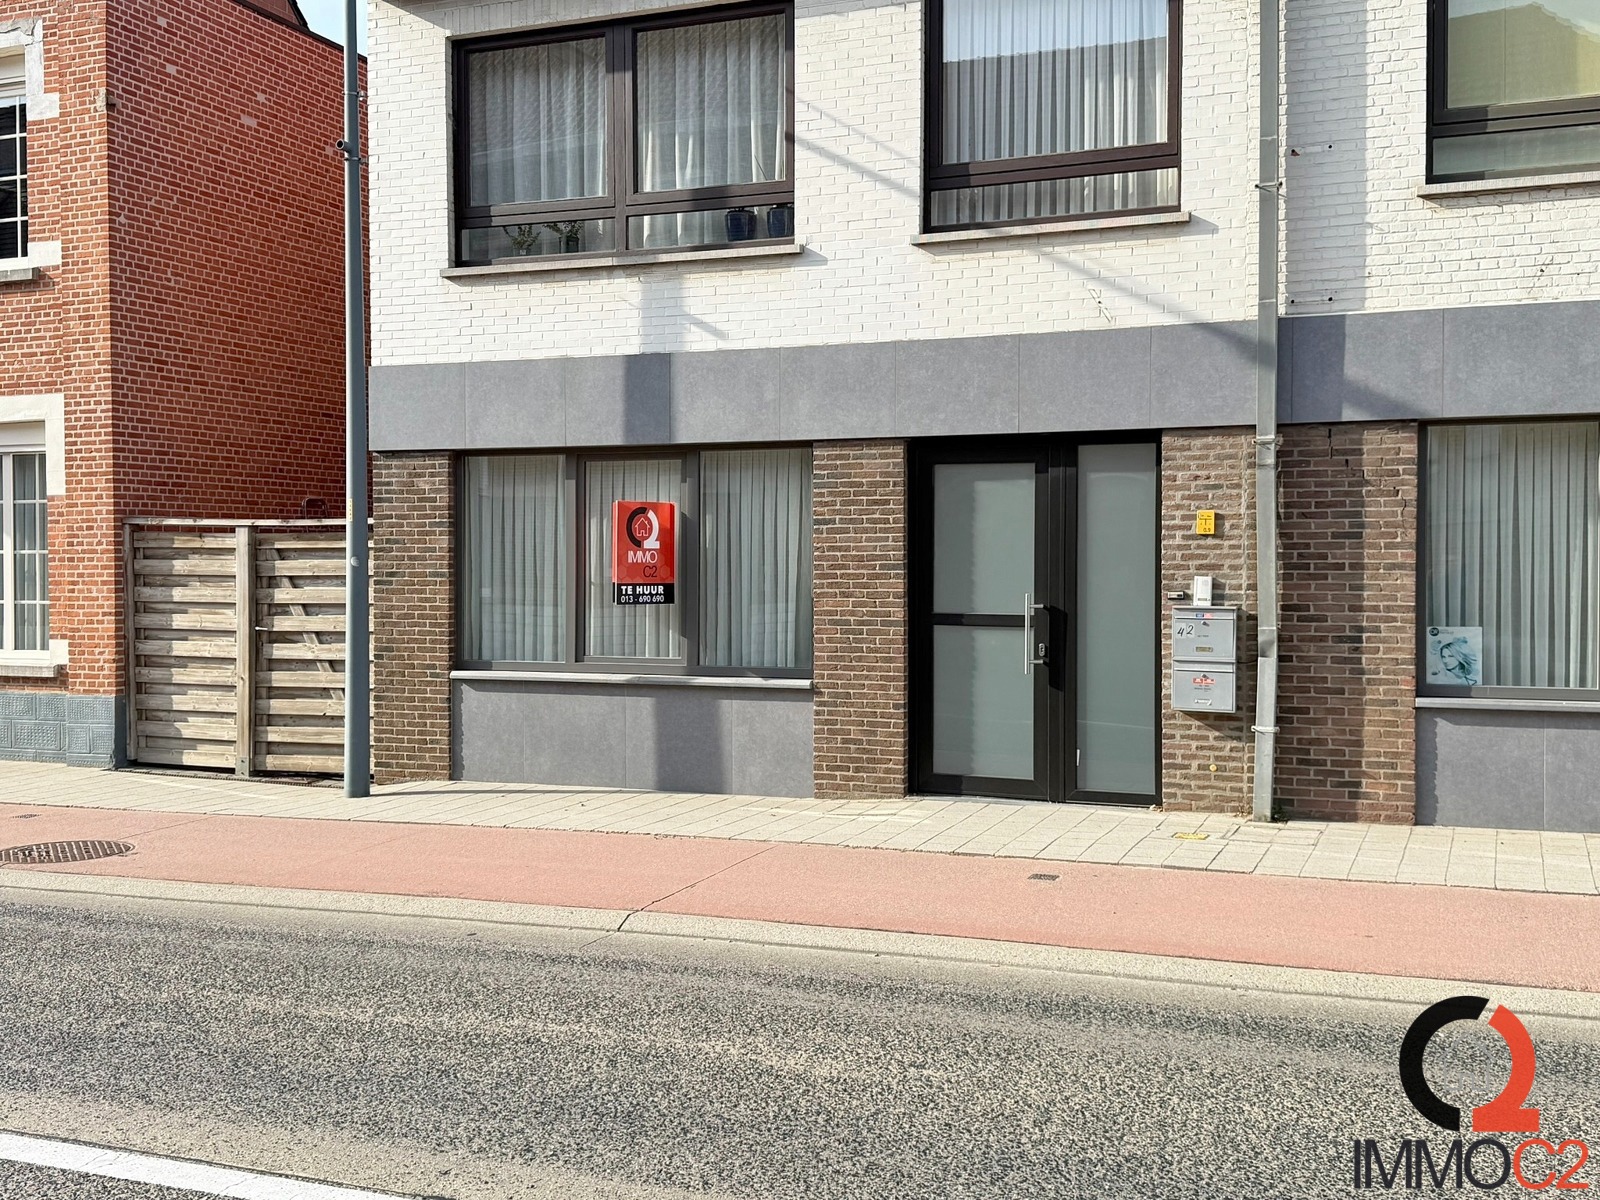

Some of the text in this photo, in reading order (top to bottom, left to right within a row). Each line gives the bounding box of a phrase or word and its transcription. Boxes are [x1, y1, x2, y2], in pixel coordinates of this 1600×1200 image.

[627, 550, 658, 564] IMMO
[643, 565, 658, 578] C2
[620, 585, 664, 595] TE HUUR
[620, 595, 634, 603] 013
[638, 595, 652, 603] 690
[652, 595, 665, 603] 690
